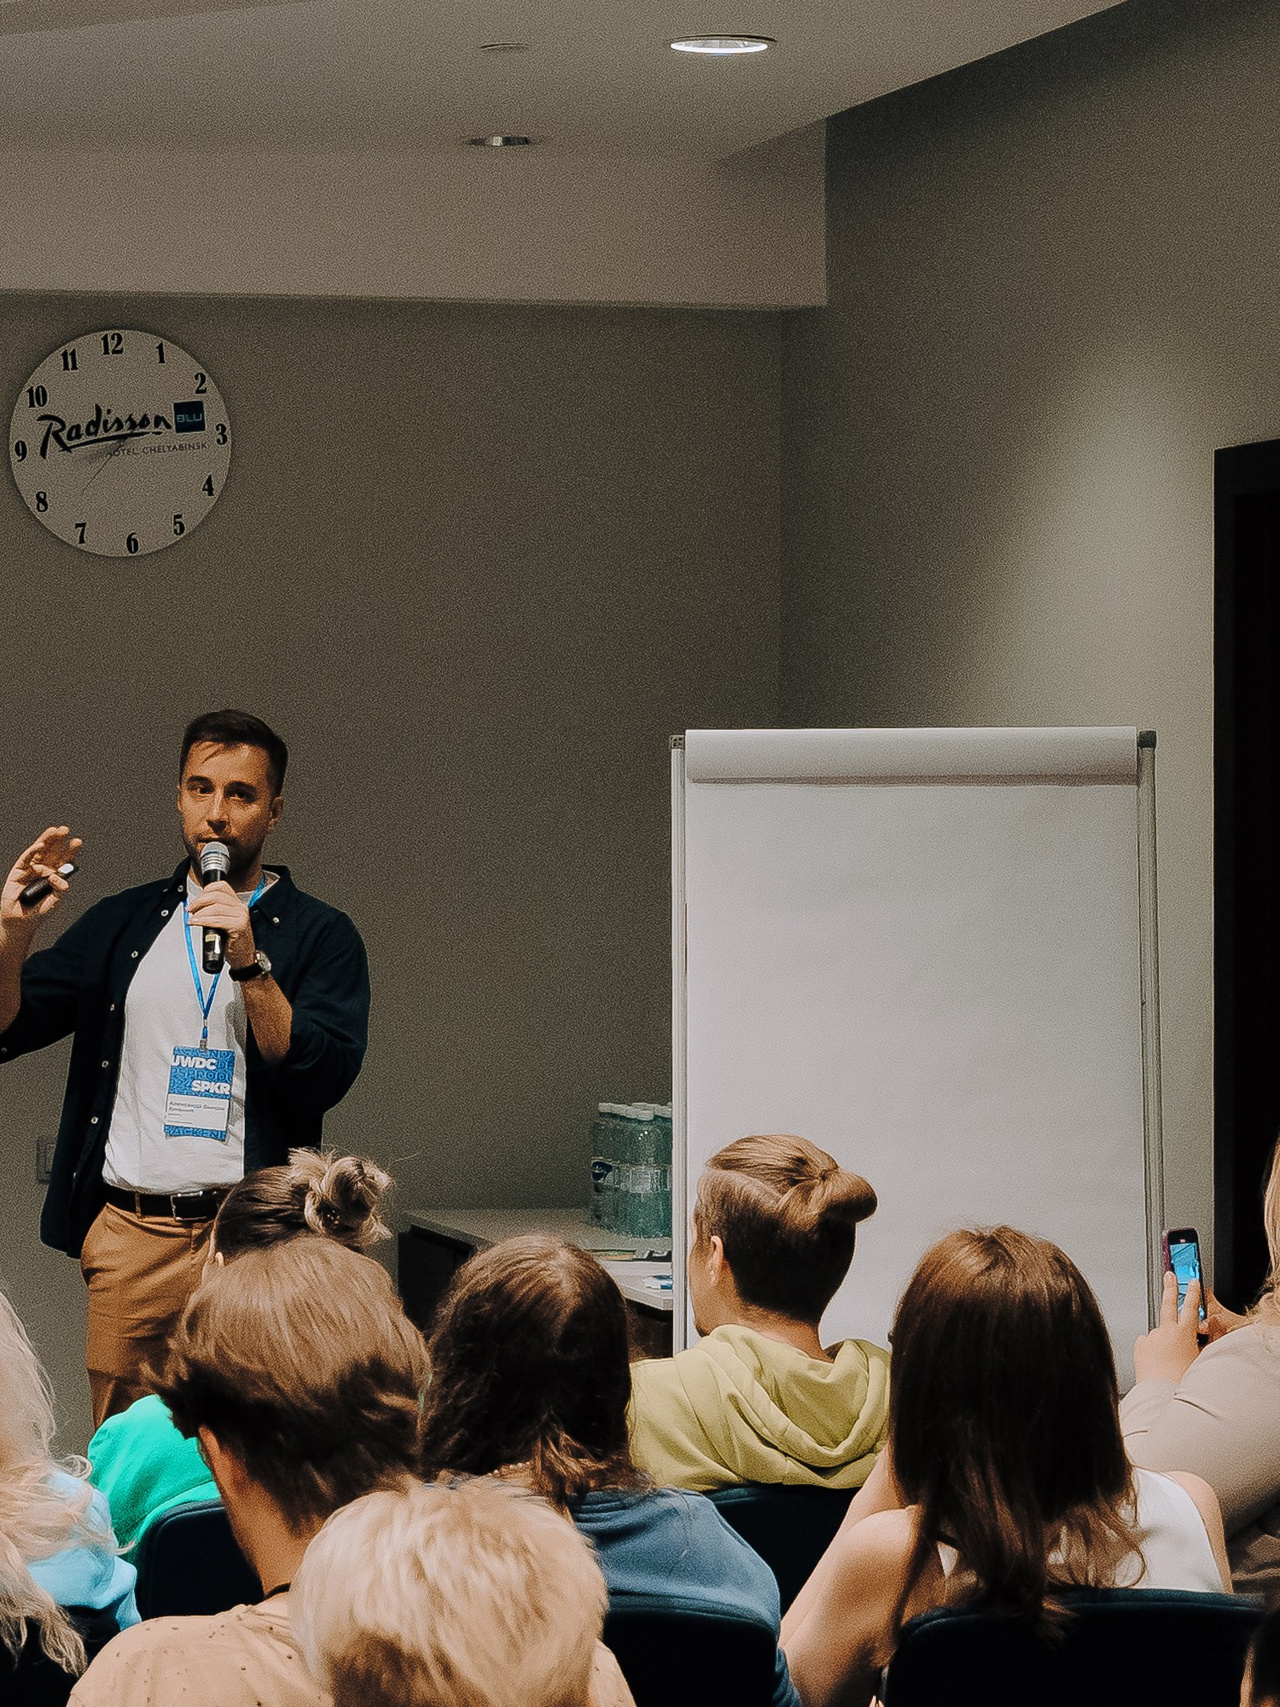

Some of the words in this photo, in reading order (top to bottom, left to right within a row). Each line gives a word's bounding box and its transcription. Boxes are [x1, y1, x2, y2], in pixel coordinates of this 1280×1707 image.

[100, 332, 124, 355] 12
[155, 342, 166, 364] 1
[60, 348, 79, 371] 11
[194, 372, 207, 394] 2
[26, 385, 48, 408] 10
[176, 413, 203, 423] BLU
[36, 403, 173, 460] Radisson
[215, 423, 228, 445] 3
[14, 440, 28, 462] 9
[202, 474, 215, 497] 4
[35, 491, 49, 512] 8
[74, 522, 87, 545] 7
[173, 514, 186, 536] 5
[125, 532, 139, 554] 6
[191, 1080, 231, 1095] SPKR
